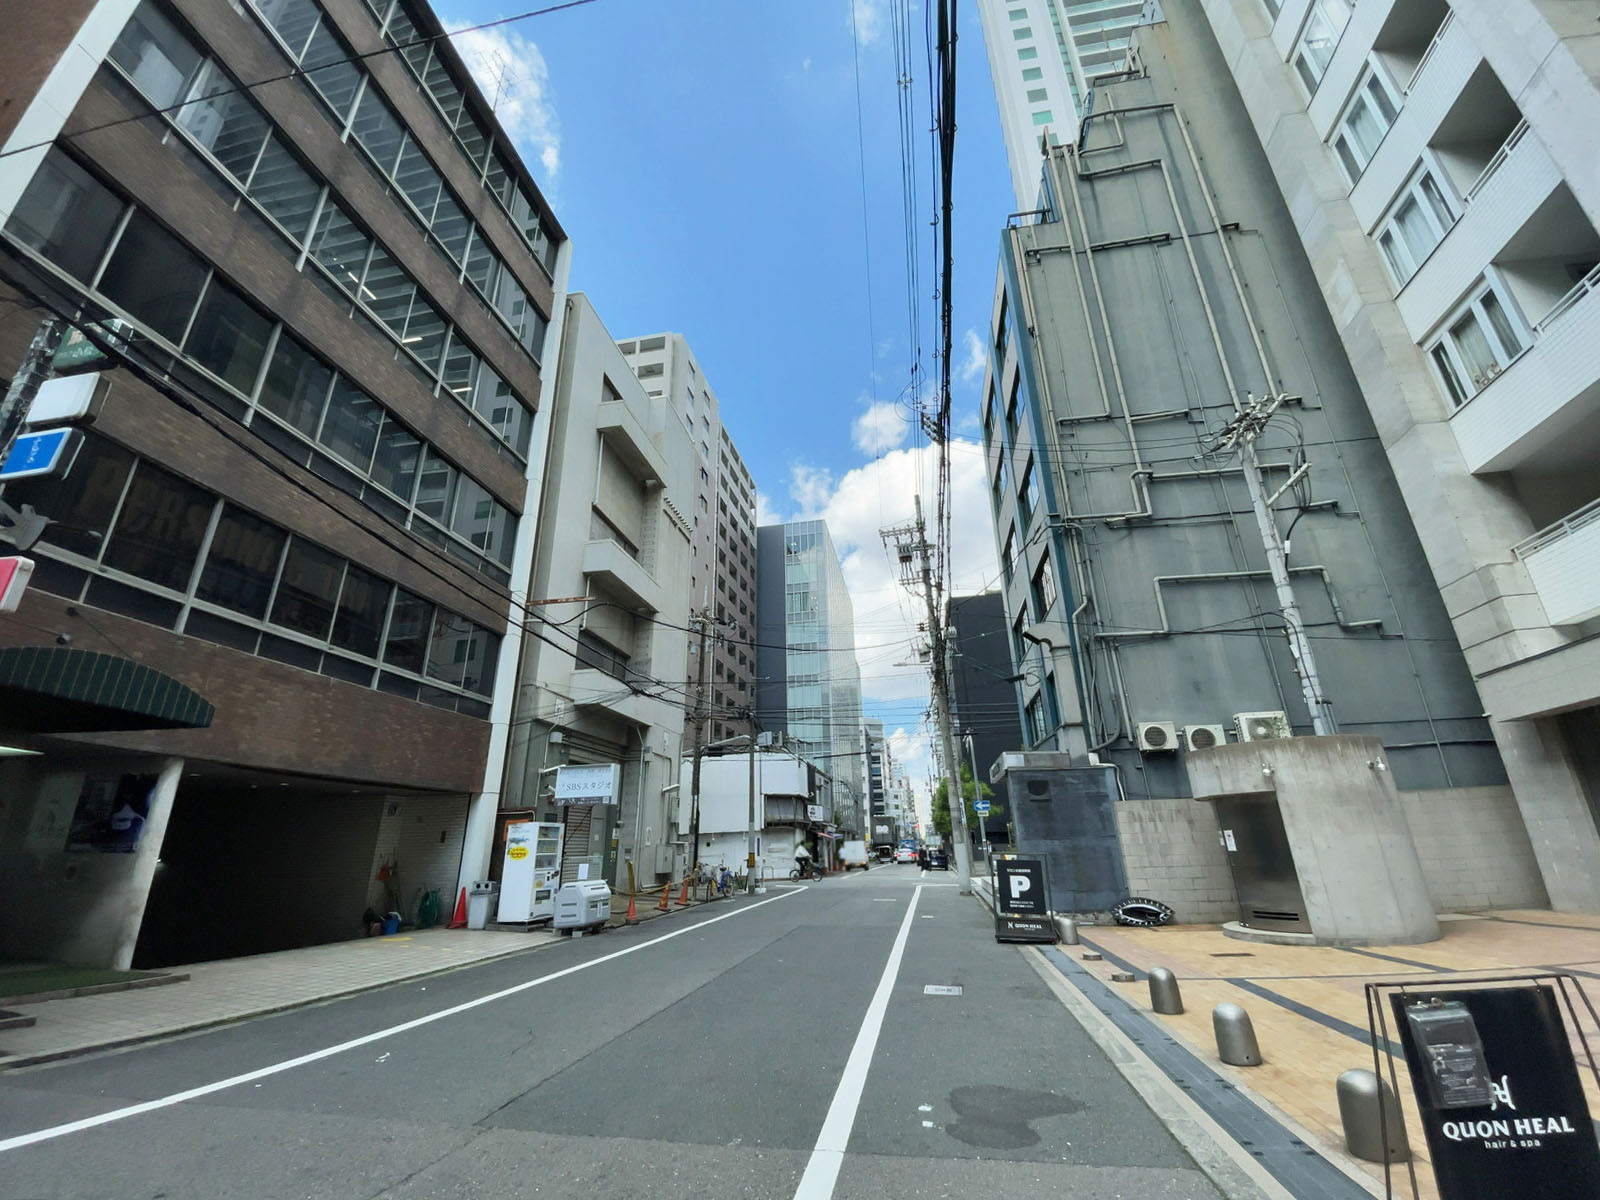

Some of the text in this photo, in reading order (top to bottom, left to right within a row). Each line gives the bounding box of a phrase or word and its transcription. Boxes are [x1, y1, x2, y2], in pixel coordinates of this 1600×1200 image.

[566, 781, 612, 791] SBSスタジオ
[1009, 875, 1031, 898] P
[1442, 1117, 1575, 1141] QUON HEAL
[1485, 1140, 1507, 1149] hair
[1520, 1139, 1541, 1149] spa
